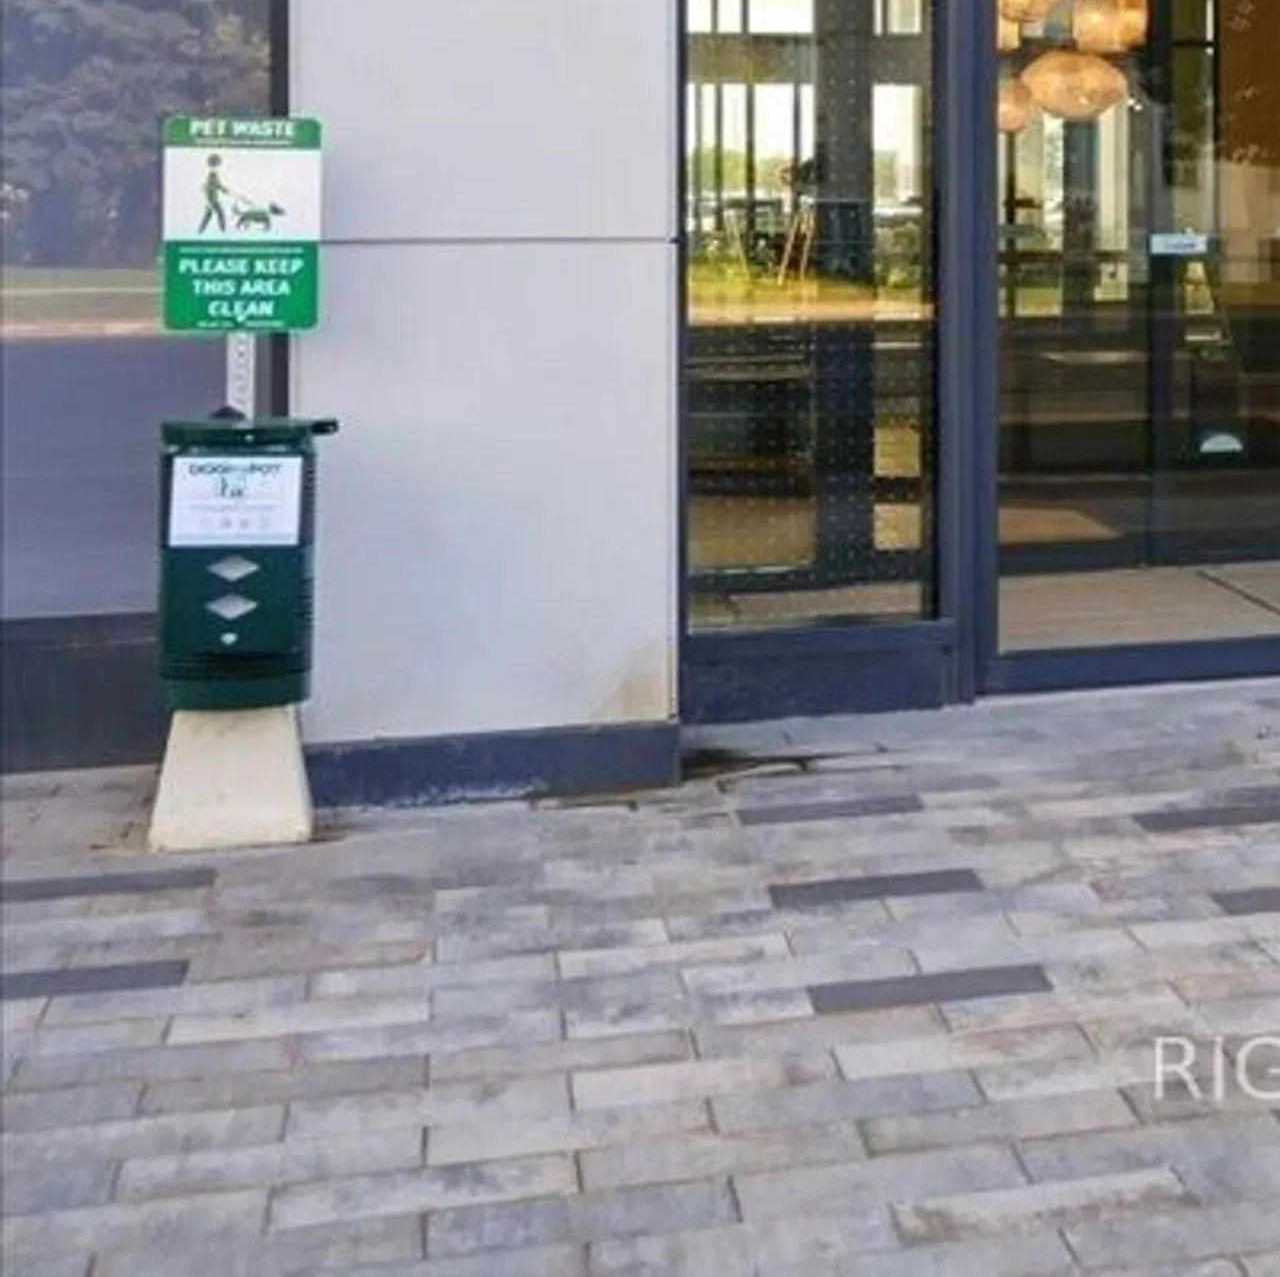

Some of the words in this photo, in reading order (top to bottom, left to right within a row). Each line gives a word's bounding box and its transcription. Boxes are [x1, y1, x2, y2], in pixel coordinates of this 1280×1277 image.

[189, 120, 226, 137] PET
[232, 120, 296, 137] WASTE
[178, 257, 249, 275] PLEASE
[253, 257, 305, 275] KEEP
[192, 279, 236, 296] THIS
[239, 279, 291, 296] AREA
[207, 299, 275, 317] CLEAN
